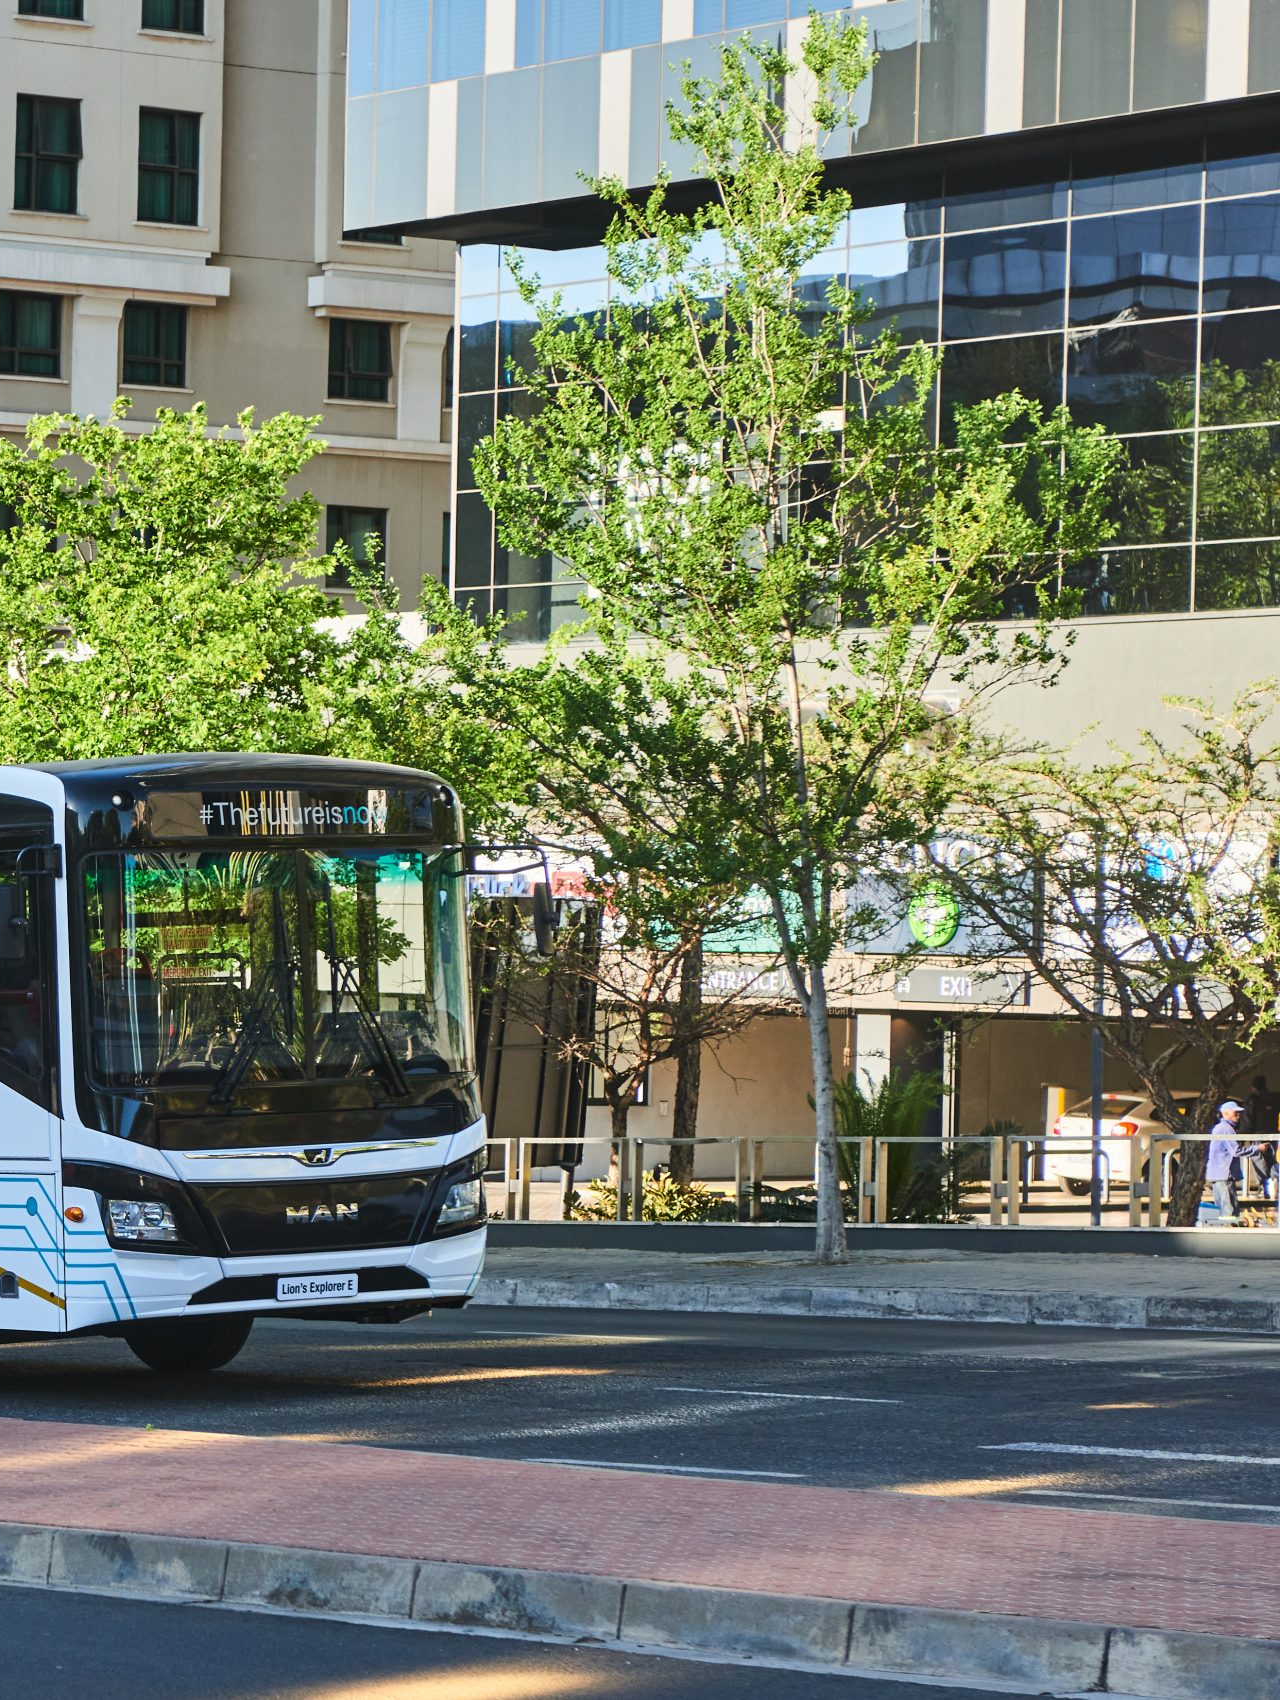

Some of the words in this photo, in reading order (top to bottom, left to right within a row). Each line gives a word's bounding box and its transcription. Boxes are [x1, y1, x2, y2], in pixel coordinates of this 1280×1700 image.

[199, 801, 388, 826] #Thefutureisnow
[198, 966, 213, 977] EXIT
[939, 976, 973, 996] EXIT
[286, 1203, 358, 1224] MAN
[282, 1283, 308, 1295] Lion's
[309, 1280, 346, 1294] Explorer
[347, 1279, 353, 1290] E
